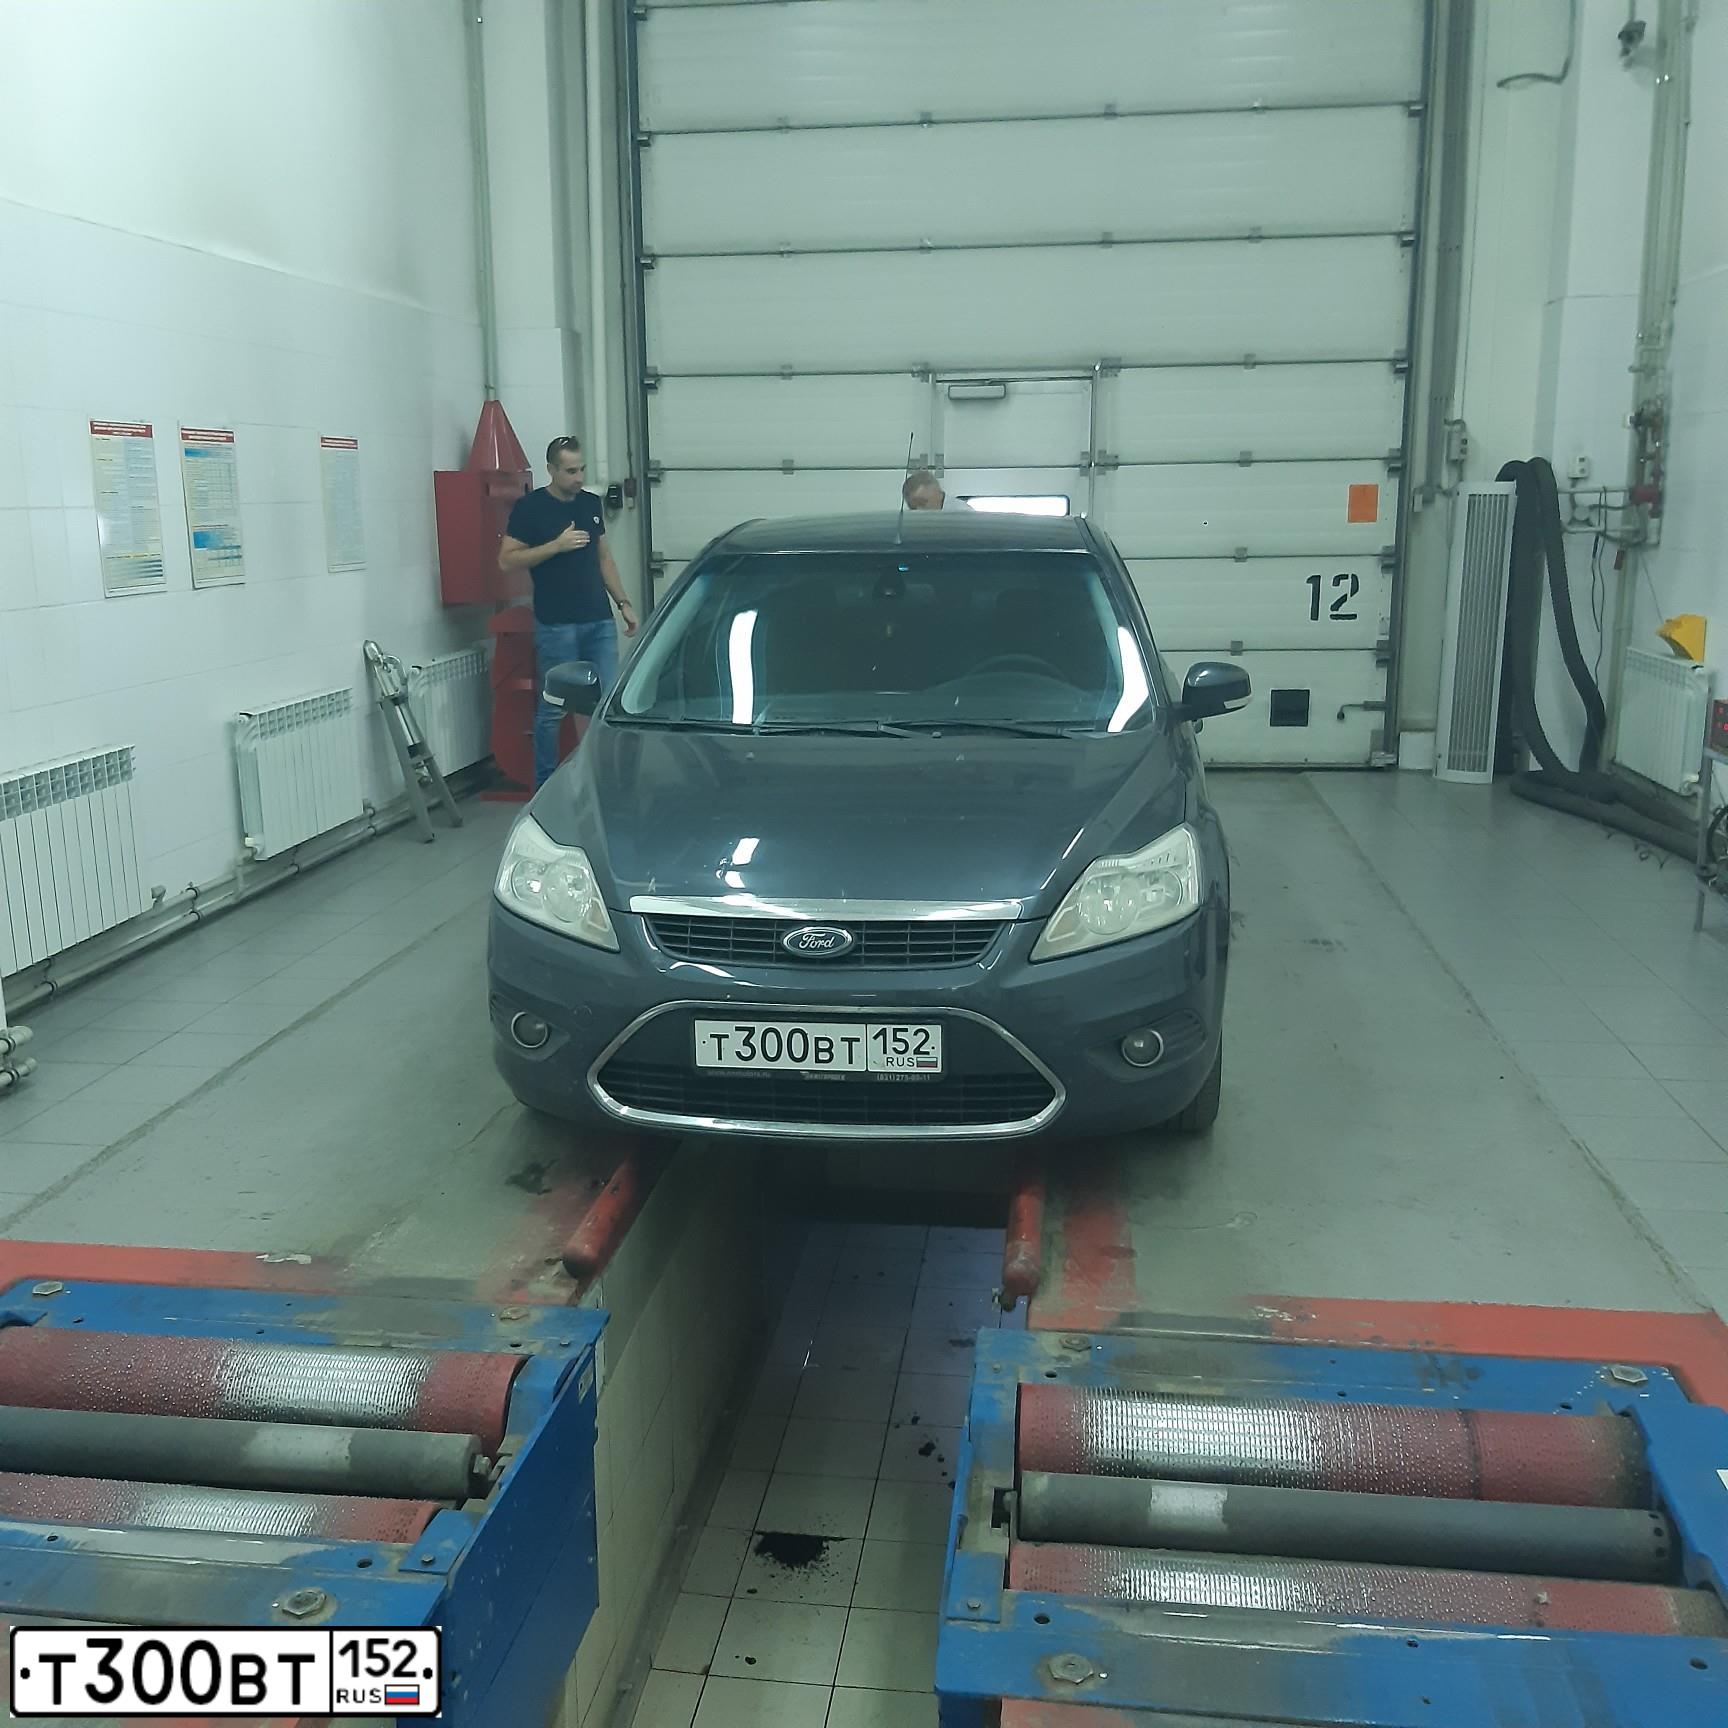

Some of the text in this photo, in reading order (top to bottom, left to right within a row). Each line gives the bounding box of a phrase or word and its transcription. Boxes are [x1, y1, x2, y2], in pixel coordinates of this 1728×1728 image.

[1306, 573, 1359, 621] 12
[799, 933, 835, 949] Ford
[872, 1027, 930, 1055] 152
[886, 1056, 915, 1067] RUS
